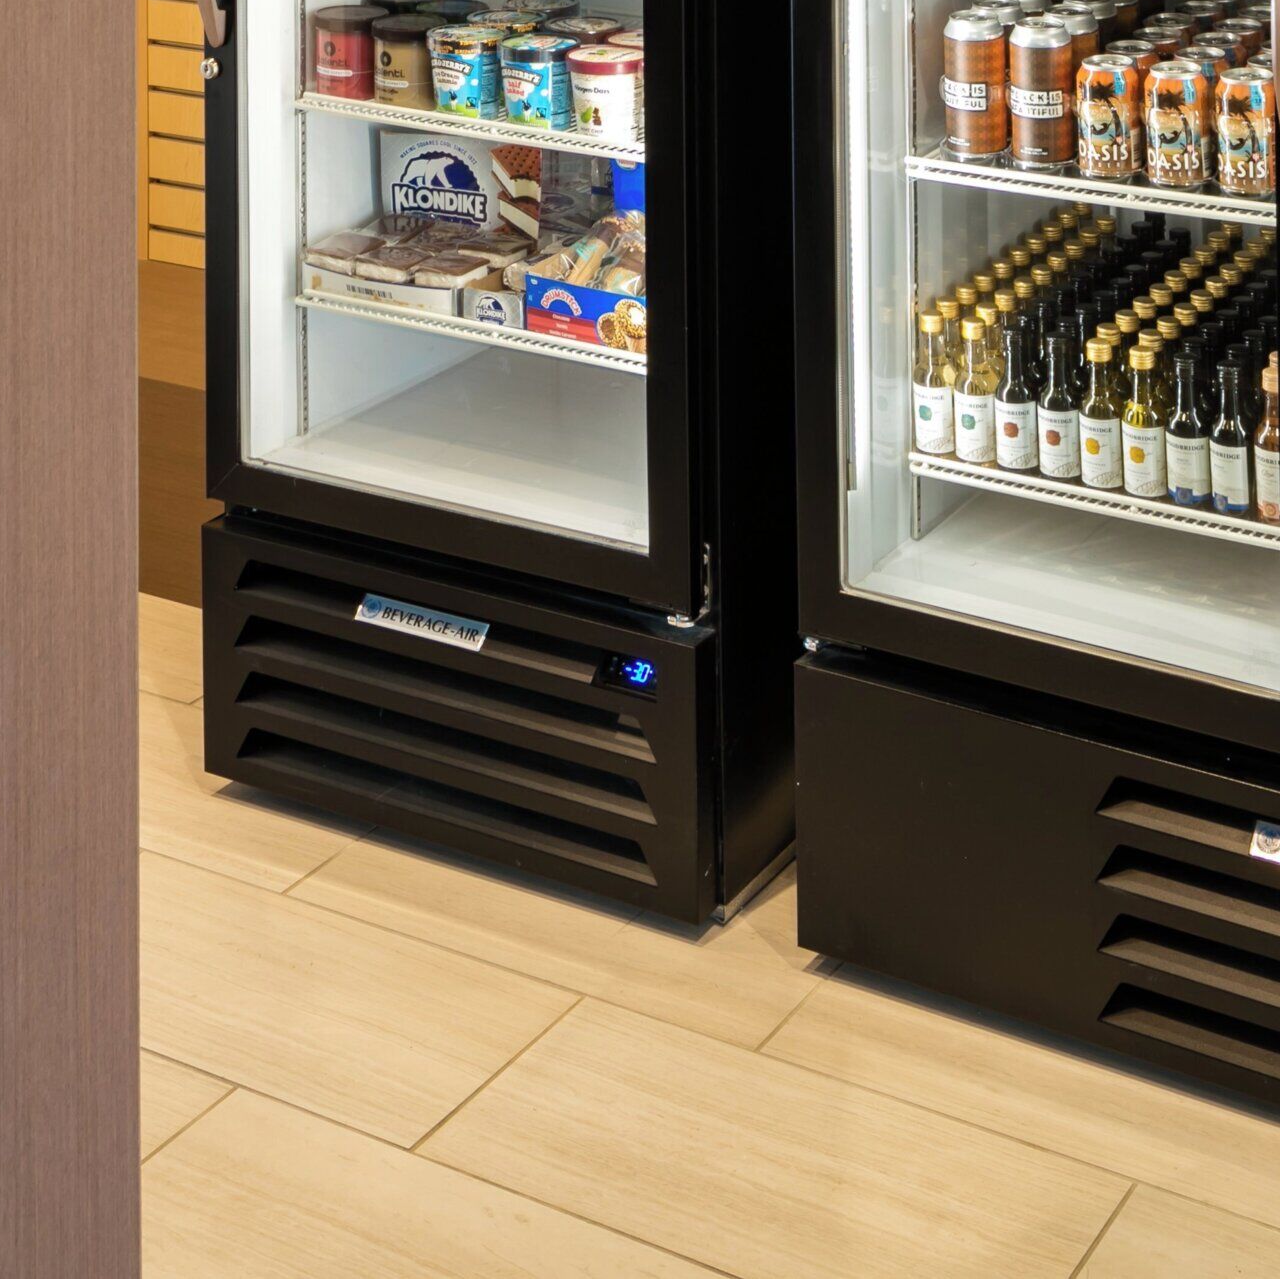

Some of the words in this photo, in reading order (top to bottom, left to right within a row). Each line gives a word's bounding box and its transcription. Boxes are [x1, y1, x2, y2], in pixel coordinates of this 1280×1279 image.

[974, 87, 983, 95] IS
[1051, 93, 1060, 102] IS
[1079, 140, 1129, 161] OASIS
[1147, 149, 1200, 171] OASIS
[394, 185, 485, 220] KLONDIKE
[541, 288, 582, 317] DRUMSTICK
[381, 606, 479, 643] BEVERAGE-AIR
